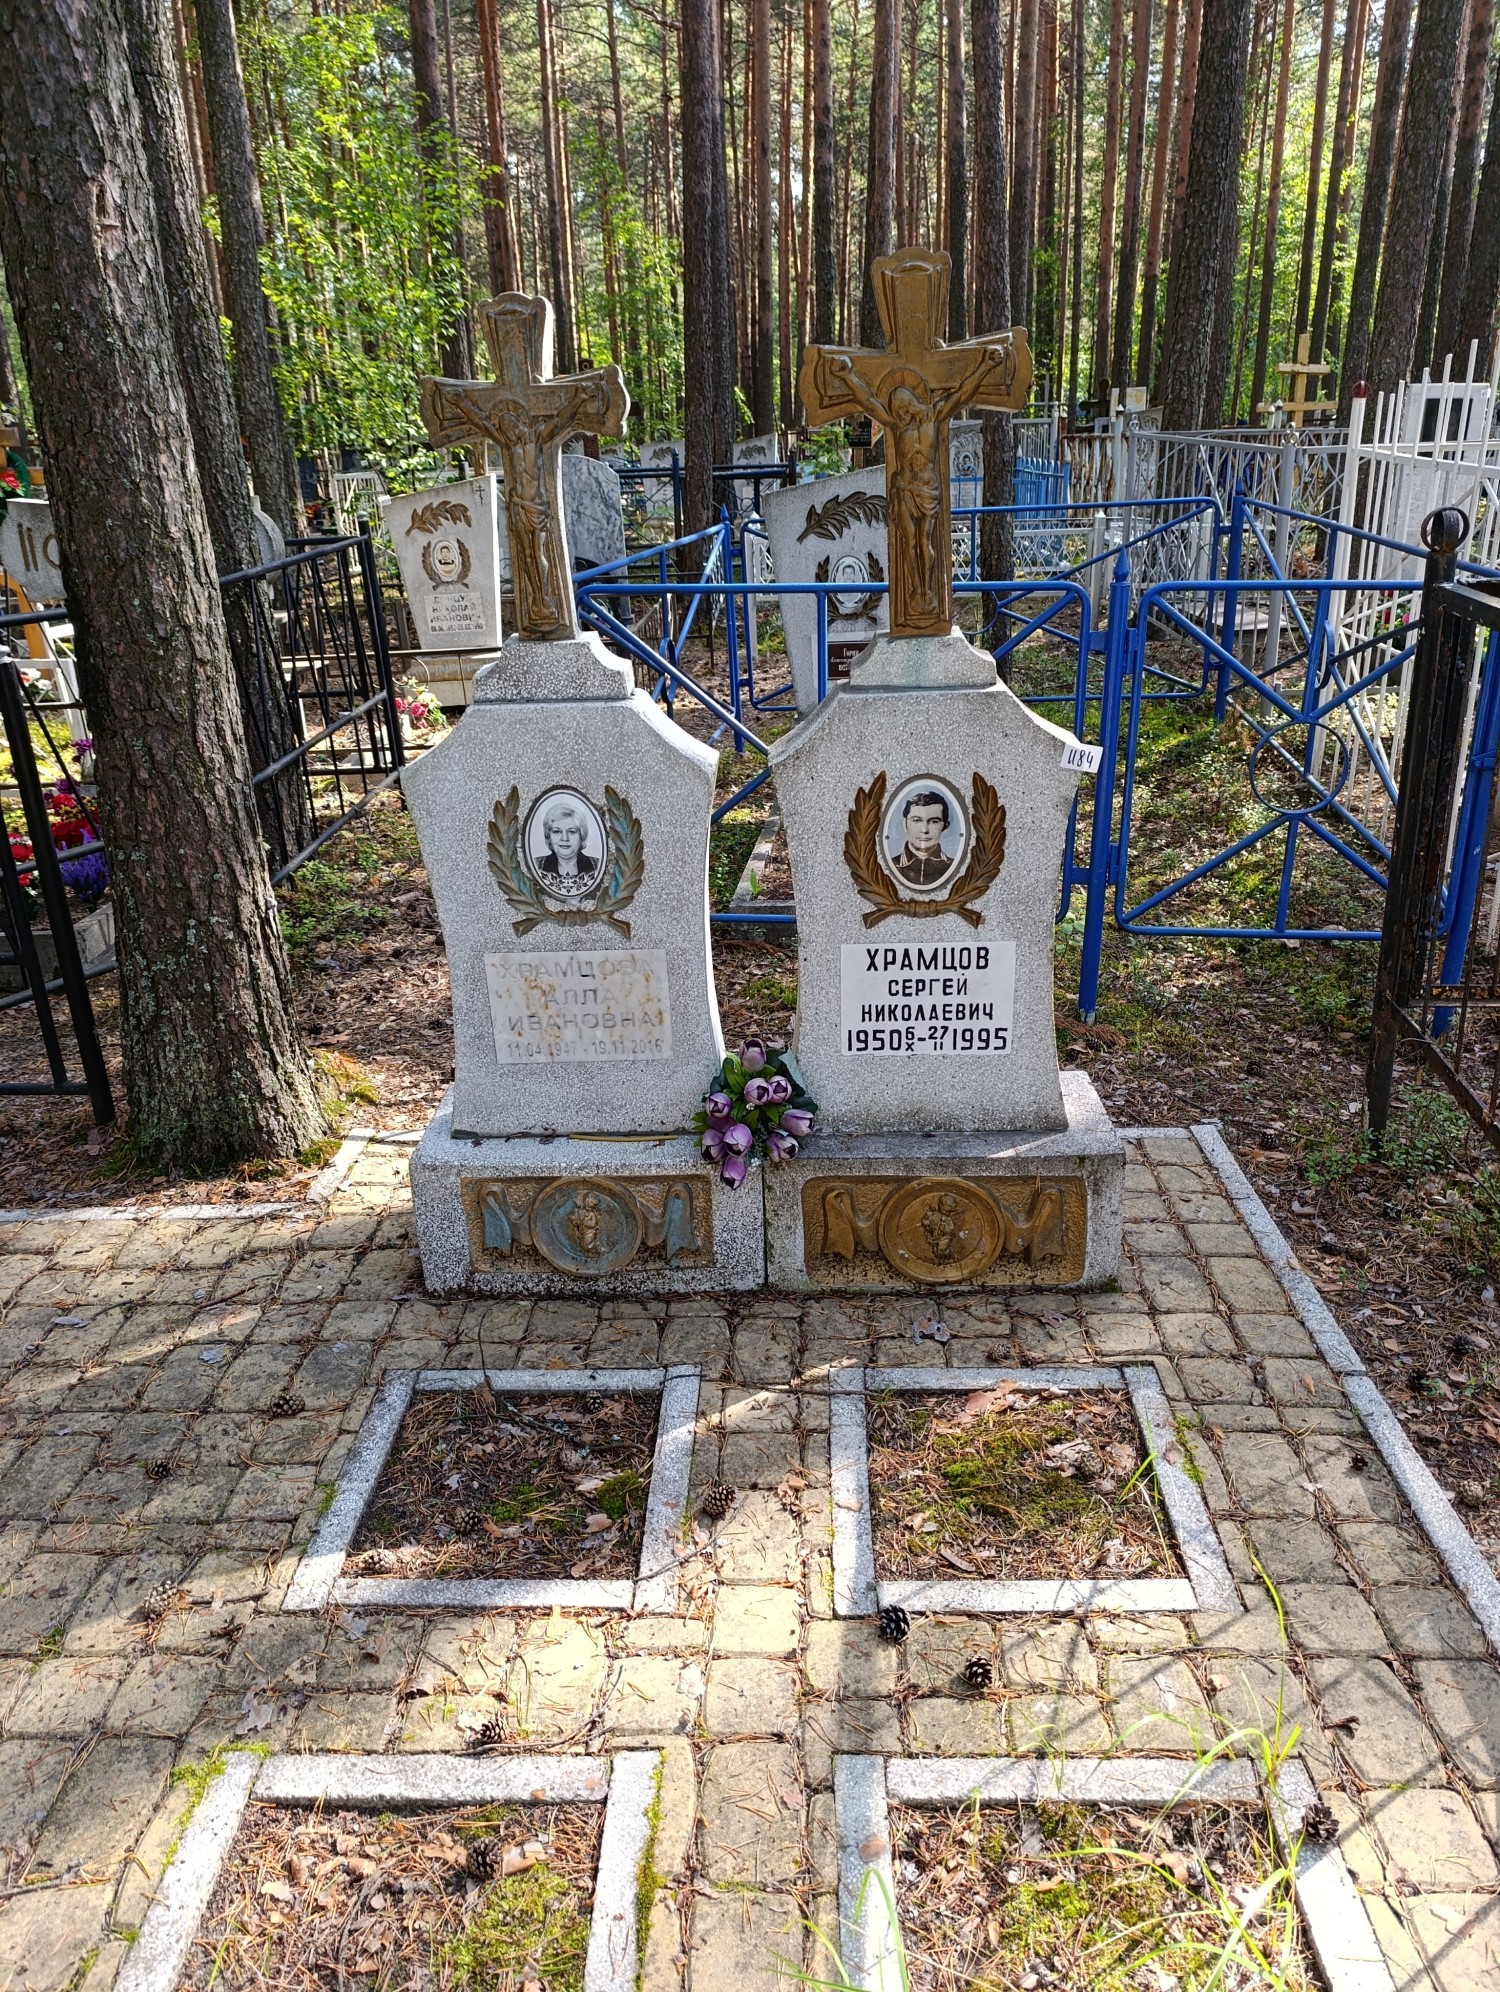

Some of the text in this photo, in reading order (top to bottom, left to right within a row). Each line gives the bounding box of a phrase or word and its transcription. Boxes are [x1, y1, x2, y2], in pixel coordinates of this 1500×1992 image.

[498, 959, 655, 980] ХРАМЦОВА
[866, 946, 990, 972] ХРАМЦОВ
[544, 988, 619, 1005] АЛЛА
[888, 976, 968, 997] СЕРГЕЙ
[507, 1011, 657, 1032] ИВАНОВНА
[861, 1002, 994, 1023] НИКОЛАЕВИЧ
